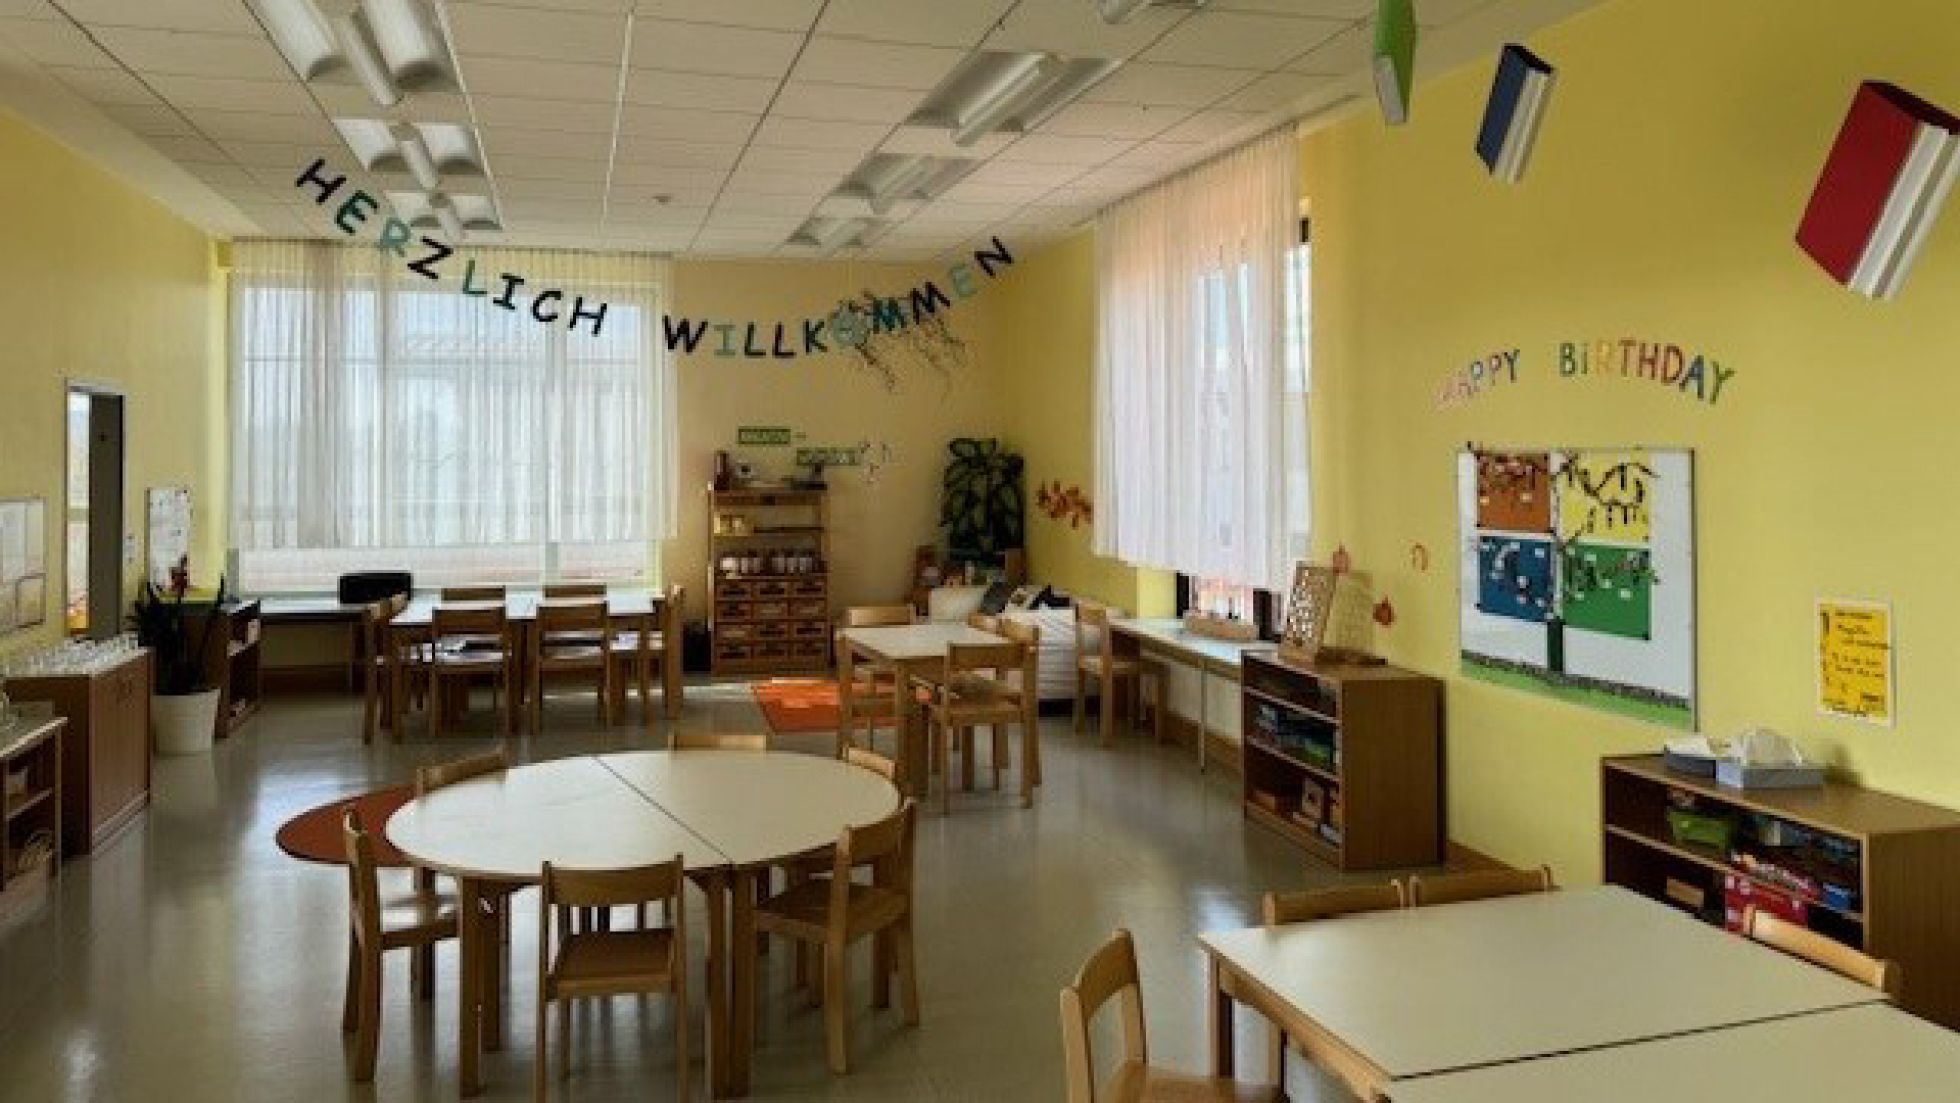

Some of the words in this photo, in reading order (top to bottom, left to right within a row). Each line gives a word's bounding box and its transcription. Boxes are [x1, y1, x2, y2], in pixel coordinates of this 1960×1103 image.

[296, 158, 608, 336] HERZLICH
[663, 236, 1013, 357] WILLKOMMEN
[1434, 347, 1521, 411] APPY
